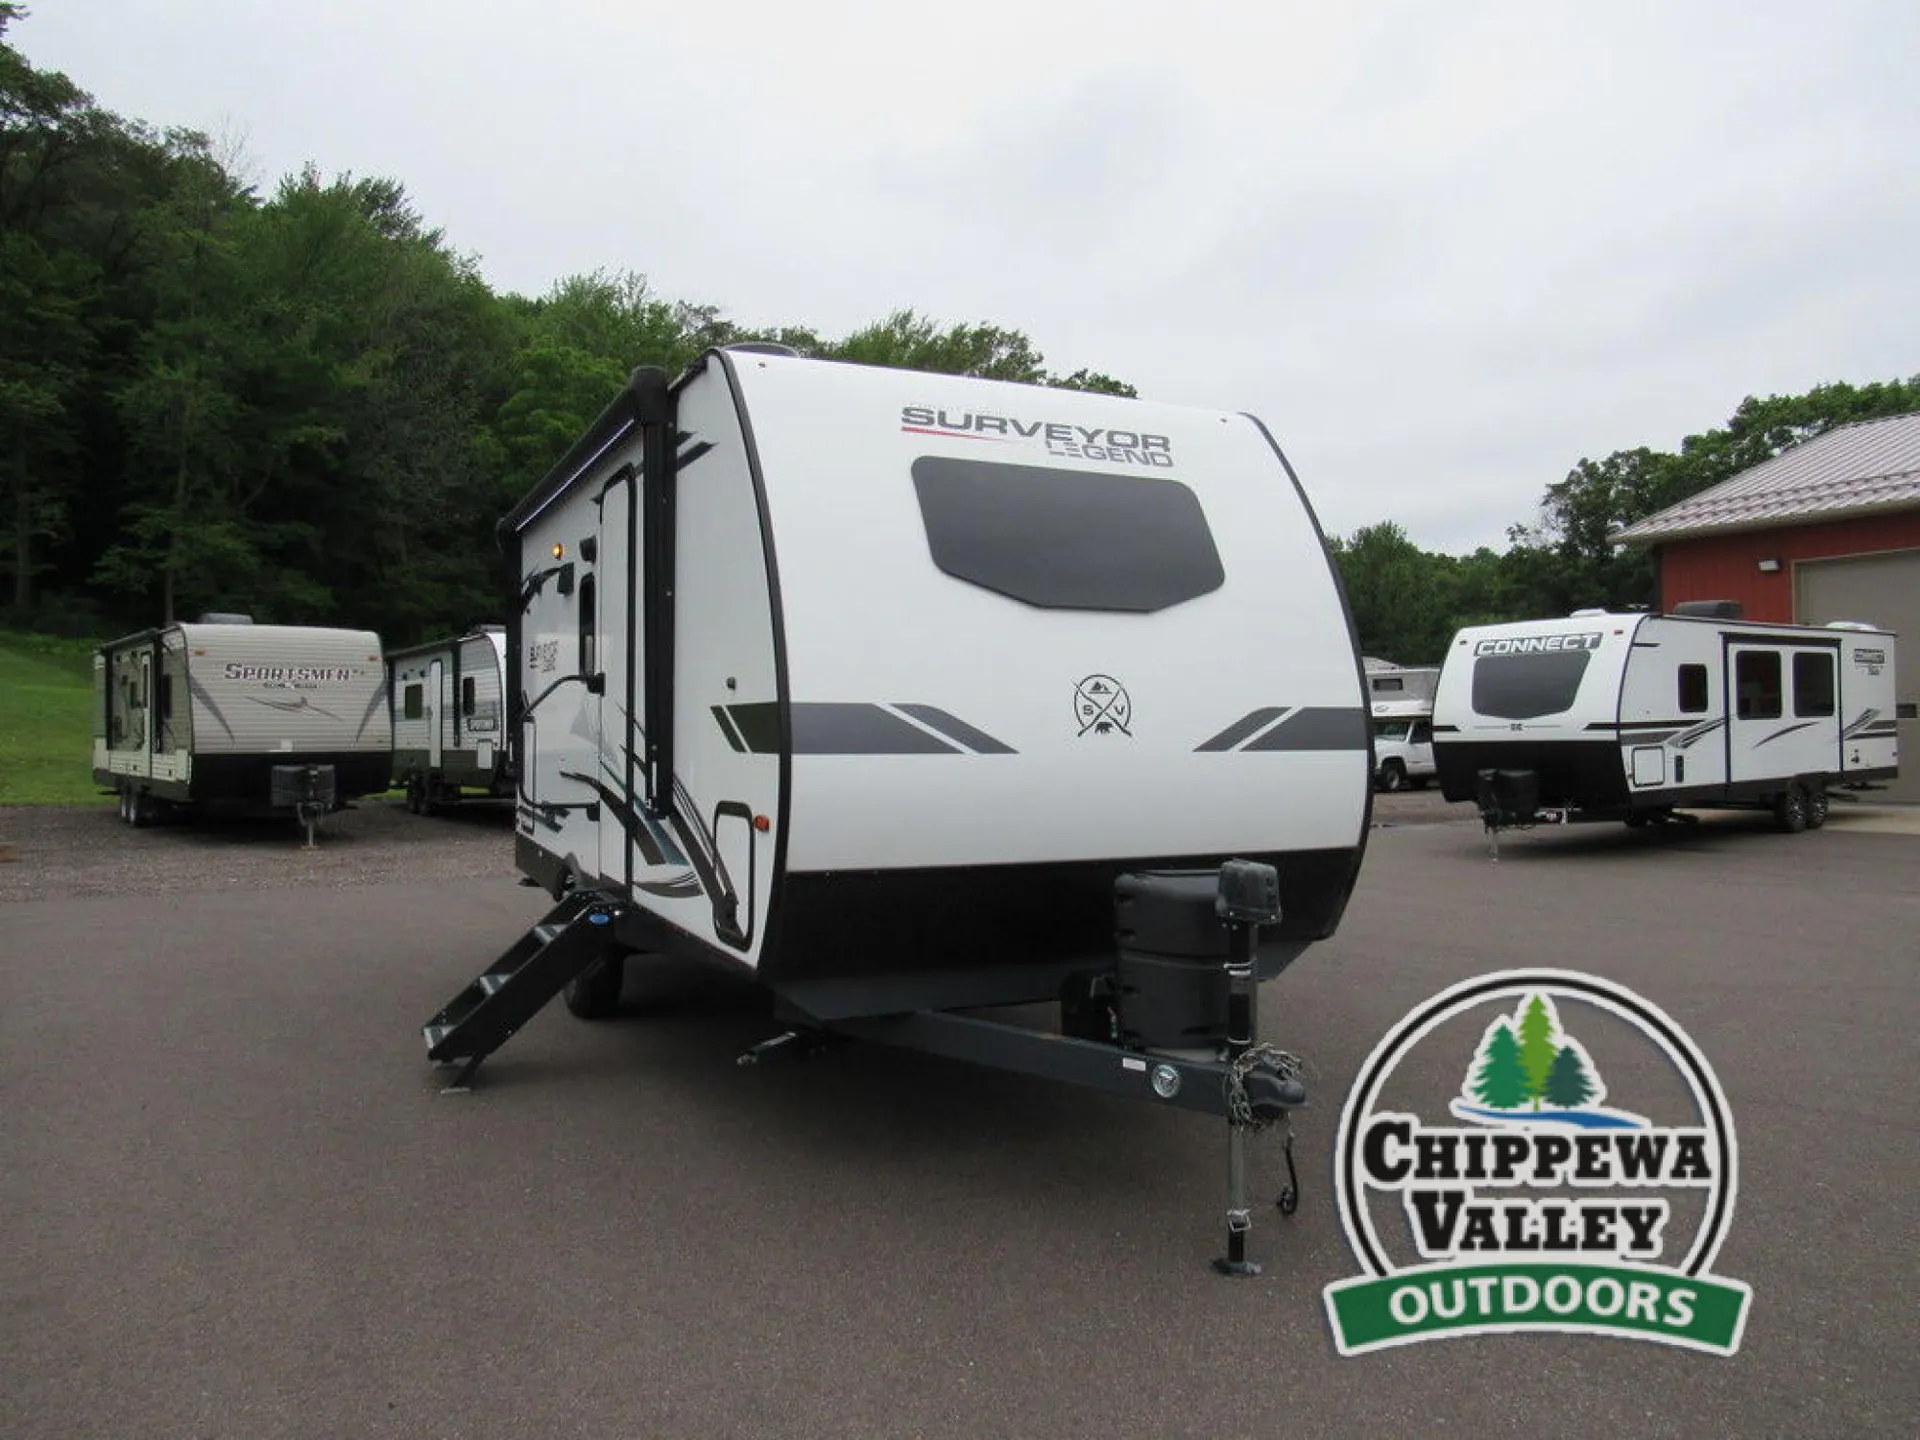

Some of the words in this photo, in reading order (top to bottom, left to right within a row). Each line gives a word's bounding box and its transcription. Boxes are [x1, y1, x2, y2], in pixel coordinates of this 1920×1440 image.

[901, 406, 1171, 452] SURVEYOR
[1047, 440, 1174, 467] LEGEND
[1478, 635, 1598, 656] CONNECT
